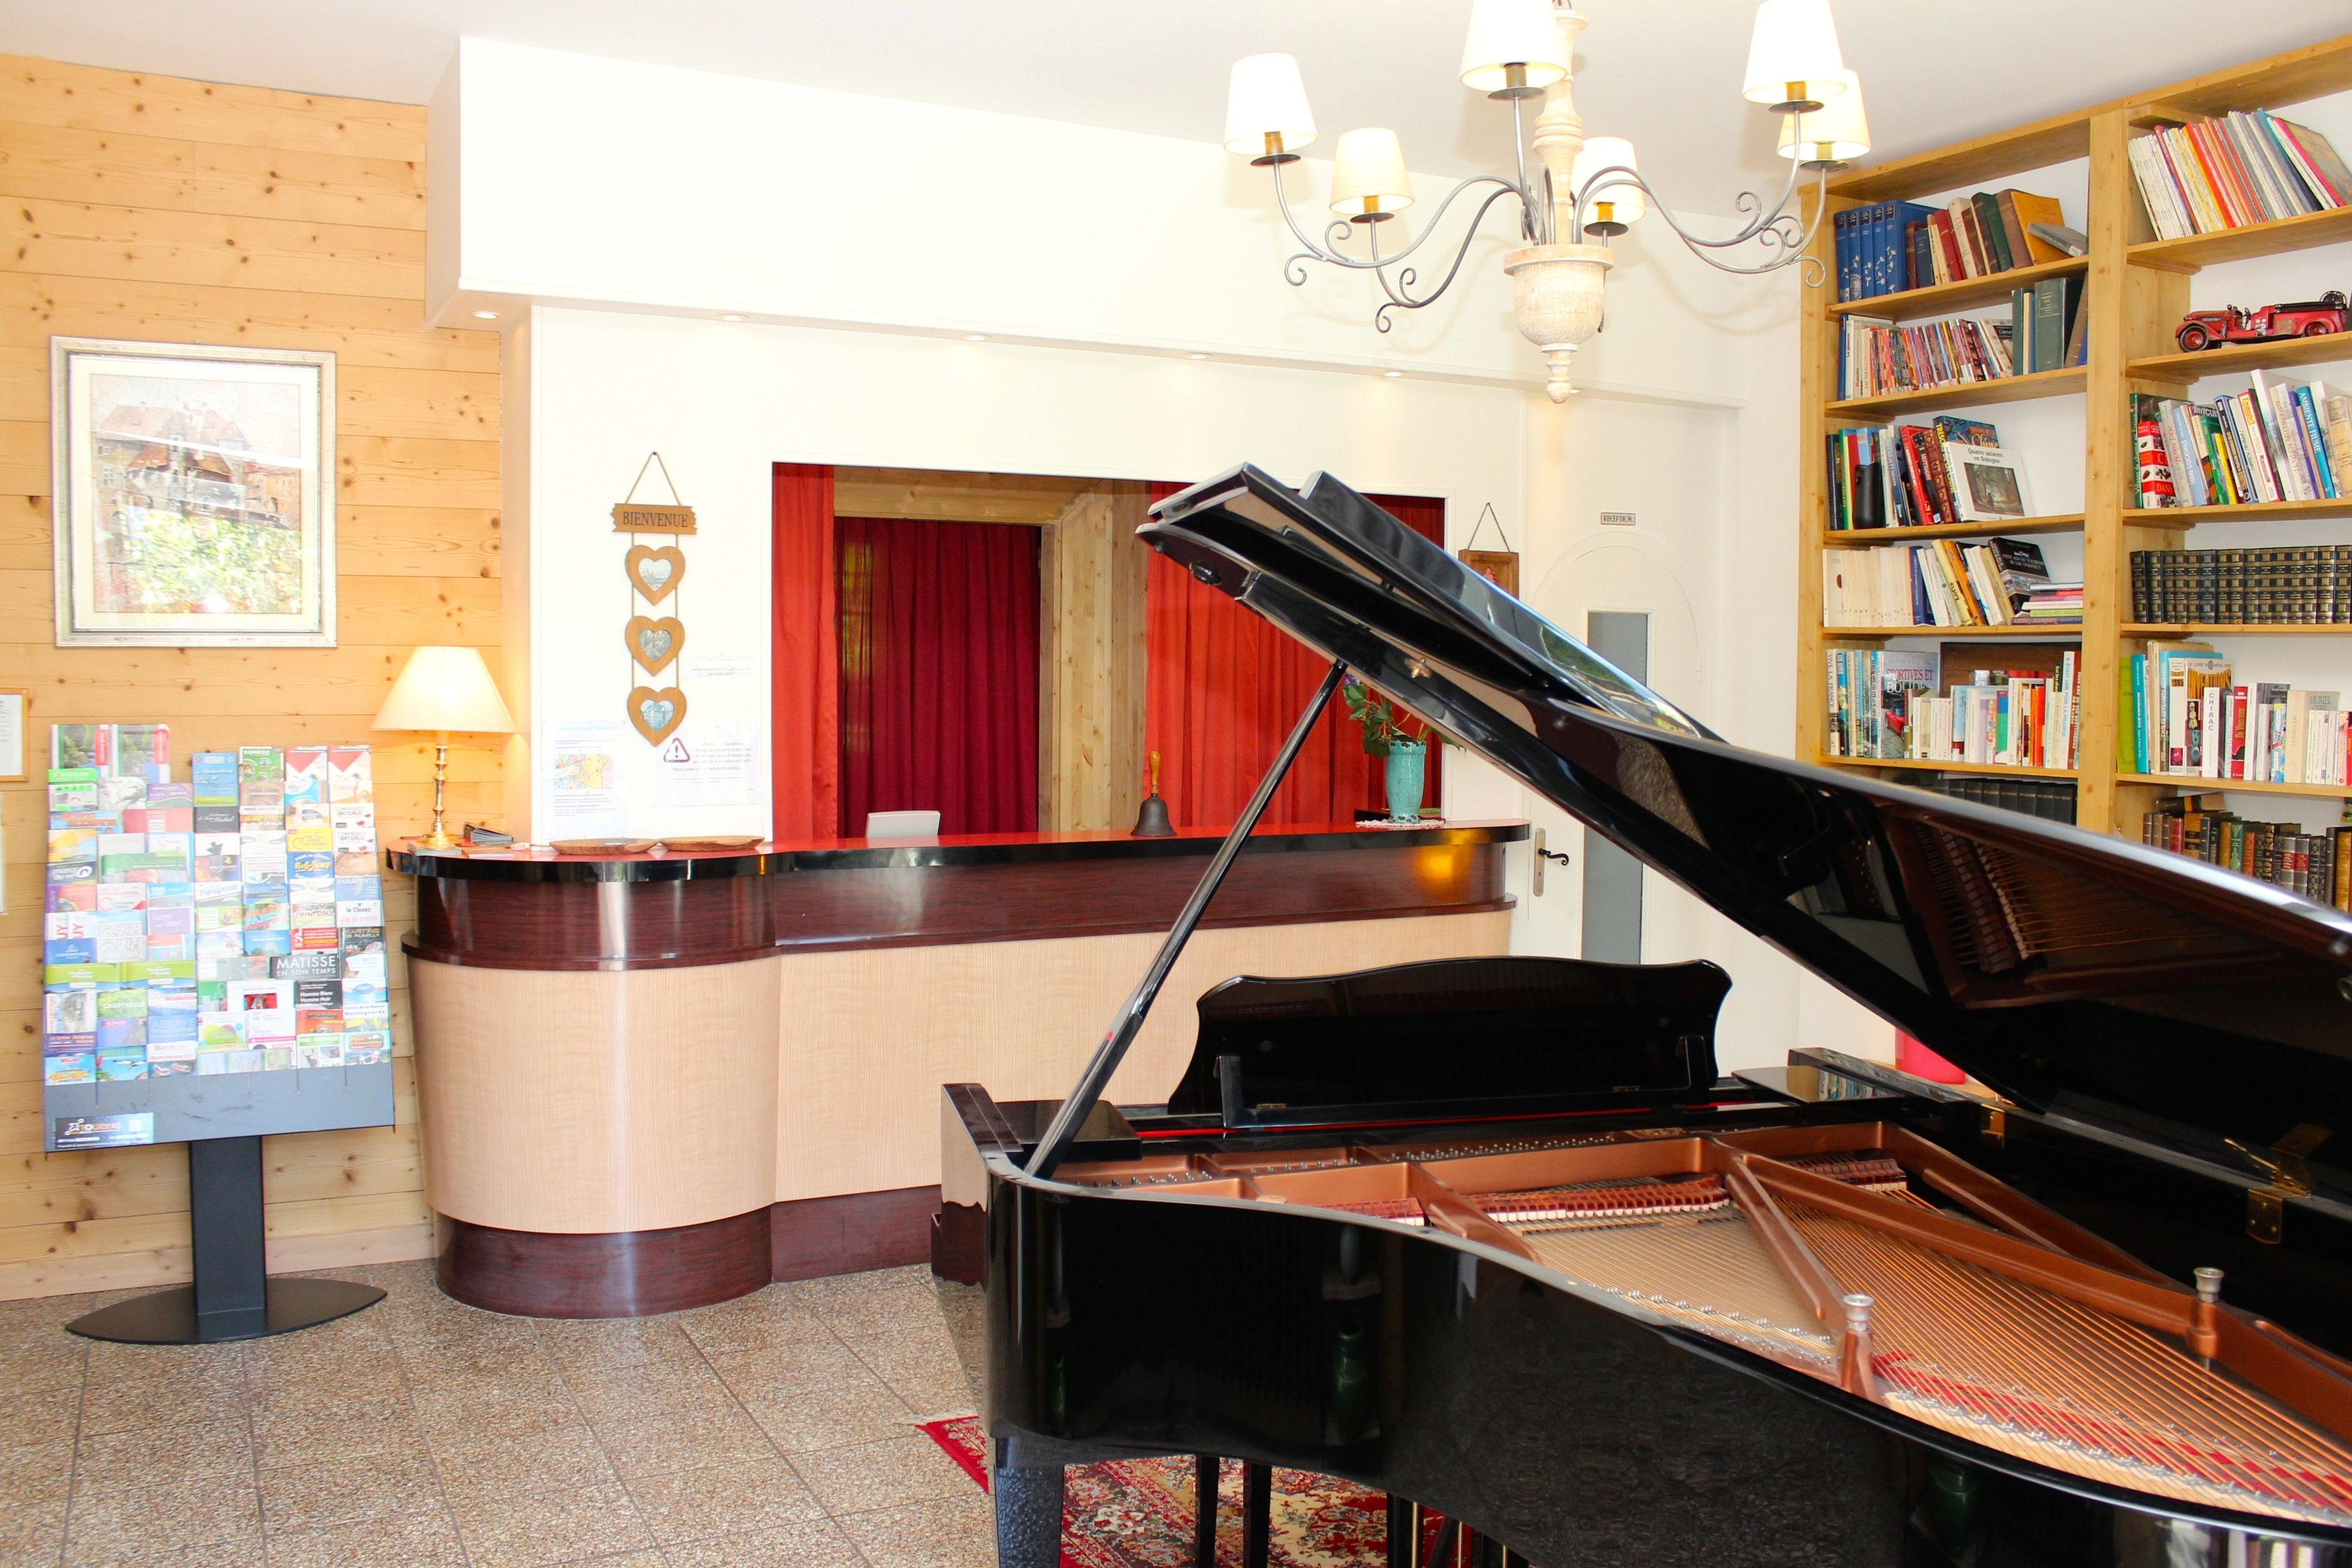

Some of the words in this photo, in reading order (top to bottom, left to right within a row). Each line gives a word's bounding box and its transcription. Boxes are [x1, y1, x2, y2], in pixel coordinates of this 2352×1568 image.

[2298, 391, 2315, 429] AMBIENTE
[2309, 429, 2322, 453] FIUME
[2181, 439, 2192, 469] COCKTAILS
[2157, 483, 2173, 492] DANS
[623, 511, 688, 527] BIENVENUE
[1948, 581, 1959, 601] Lofts
[1887, 669, 1923, 680] SPORTIVES
[1925, 669, 1934, 680] ET
[1887, 681, 1926, 693] BOLIDE
[2309, 696, 2332, 704] MURIEL
[277, 956, 336, 969] MATISSE
